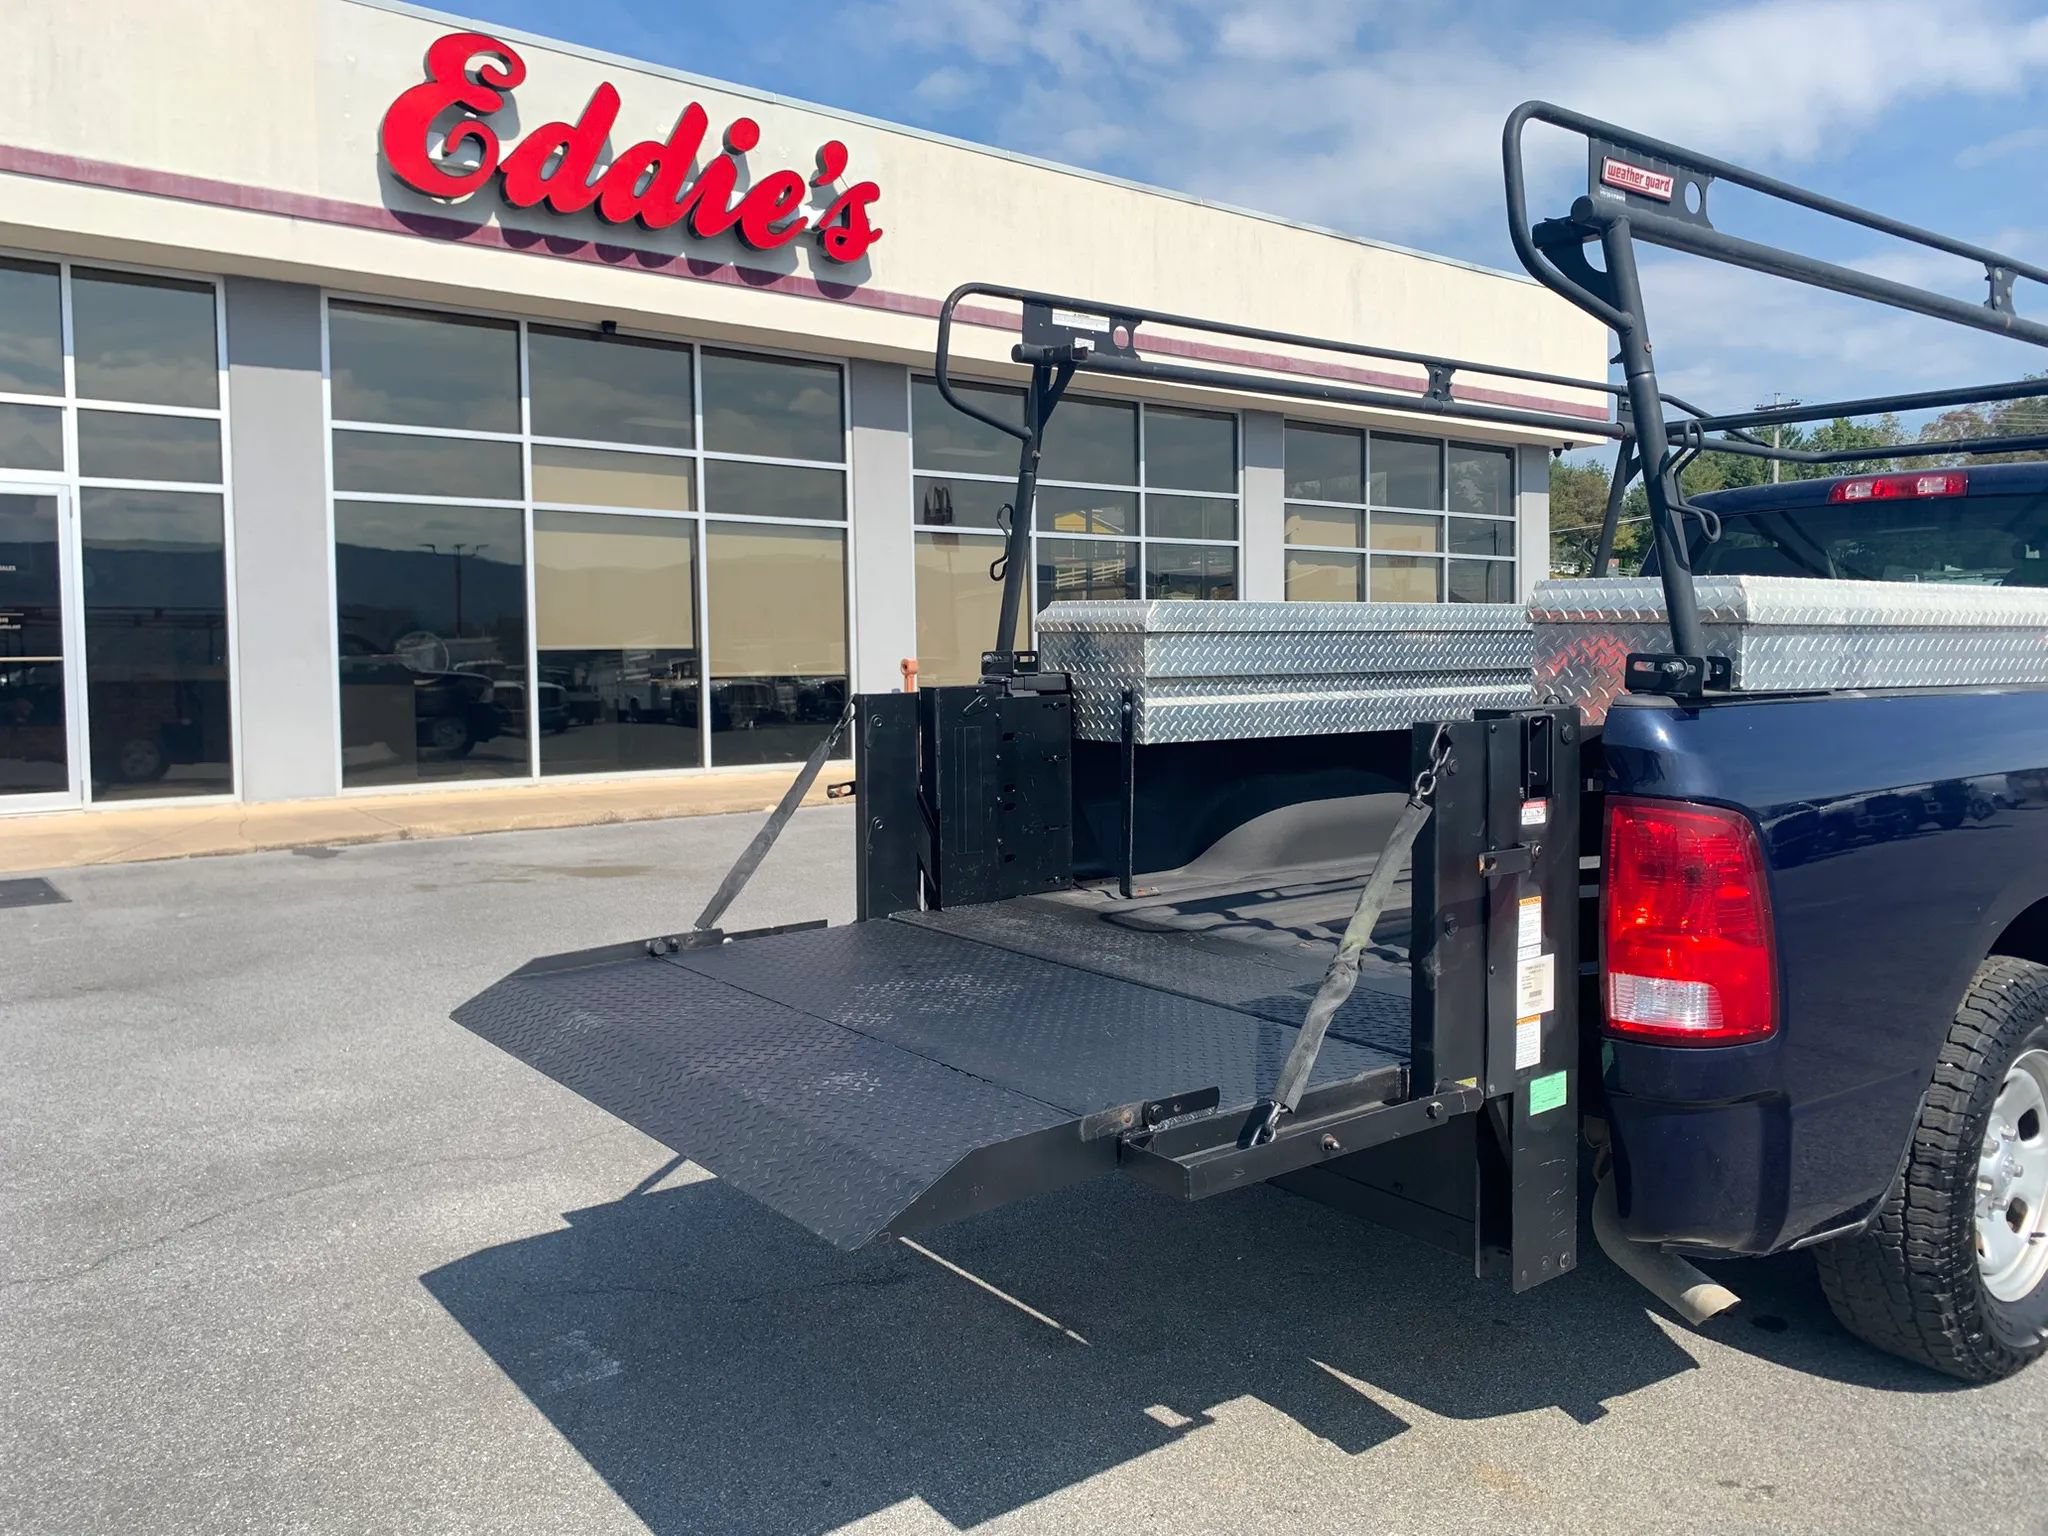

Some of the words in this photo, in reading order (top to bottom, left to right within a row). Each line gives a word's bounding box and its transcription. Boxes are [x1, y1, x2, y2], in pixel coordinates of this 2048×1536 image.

[380, 32, 883, 265] Eddie's
[1607, 165, 1645, 184] weather
[1645, 175, 1671, 192] guard
